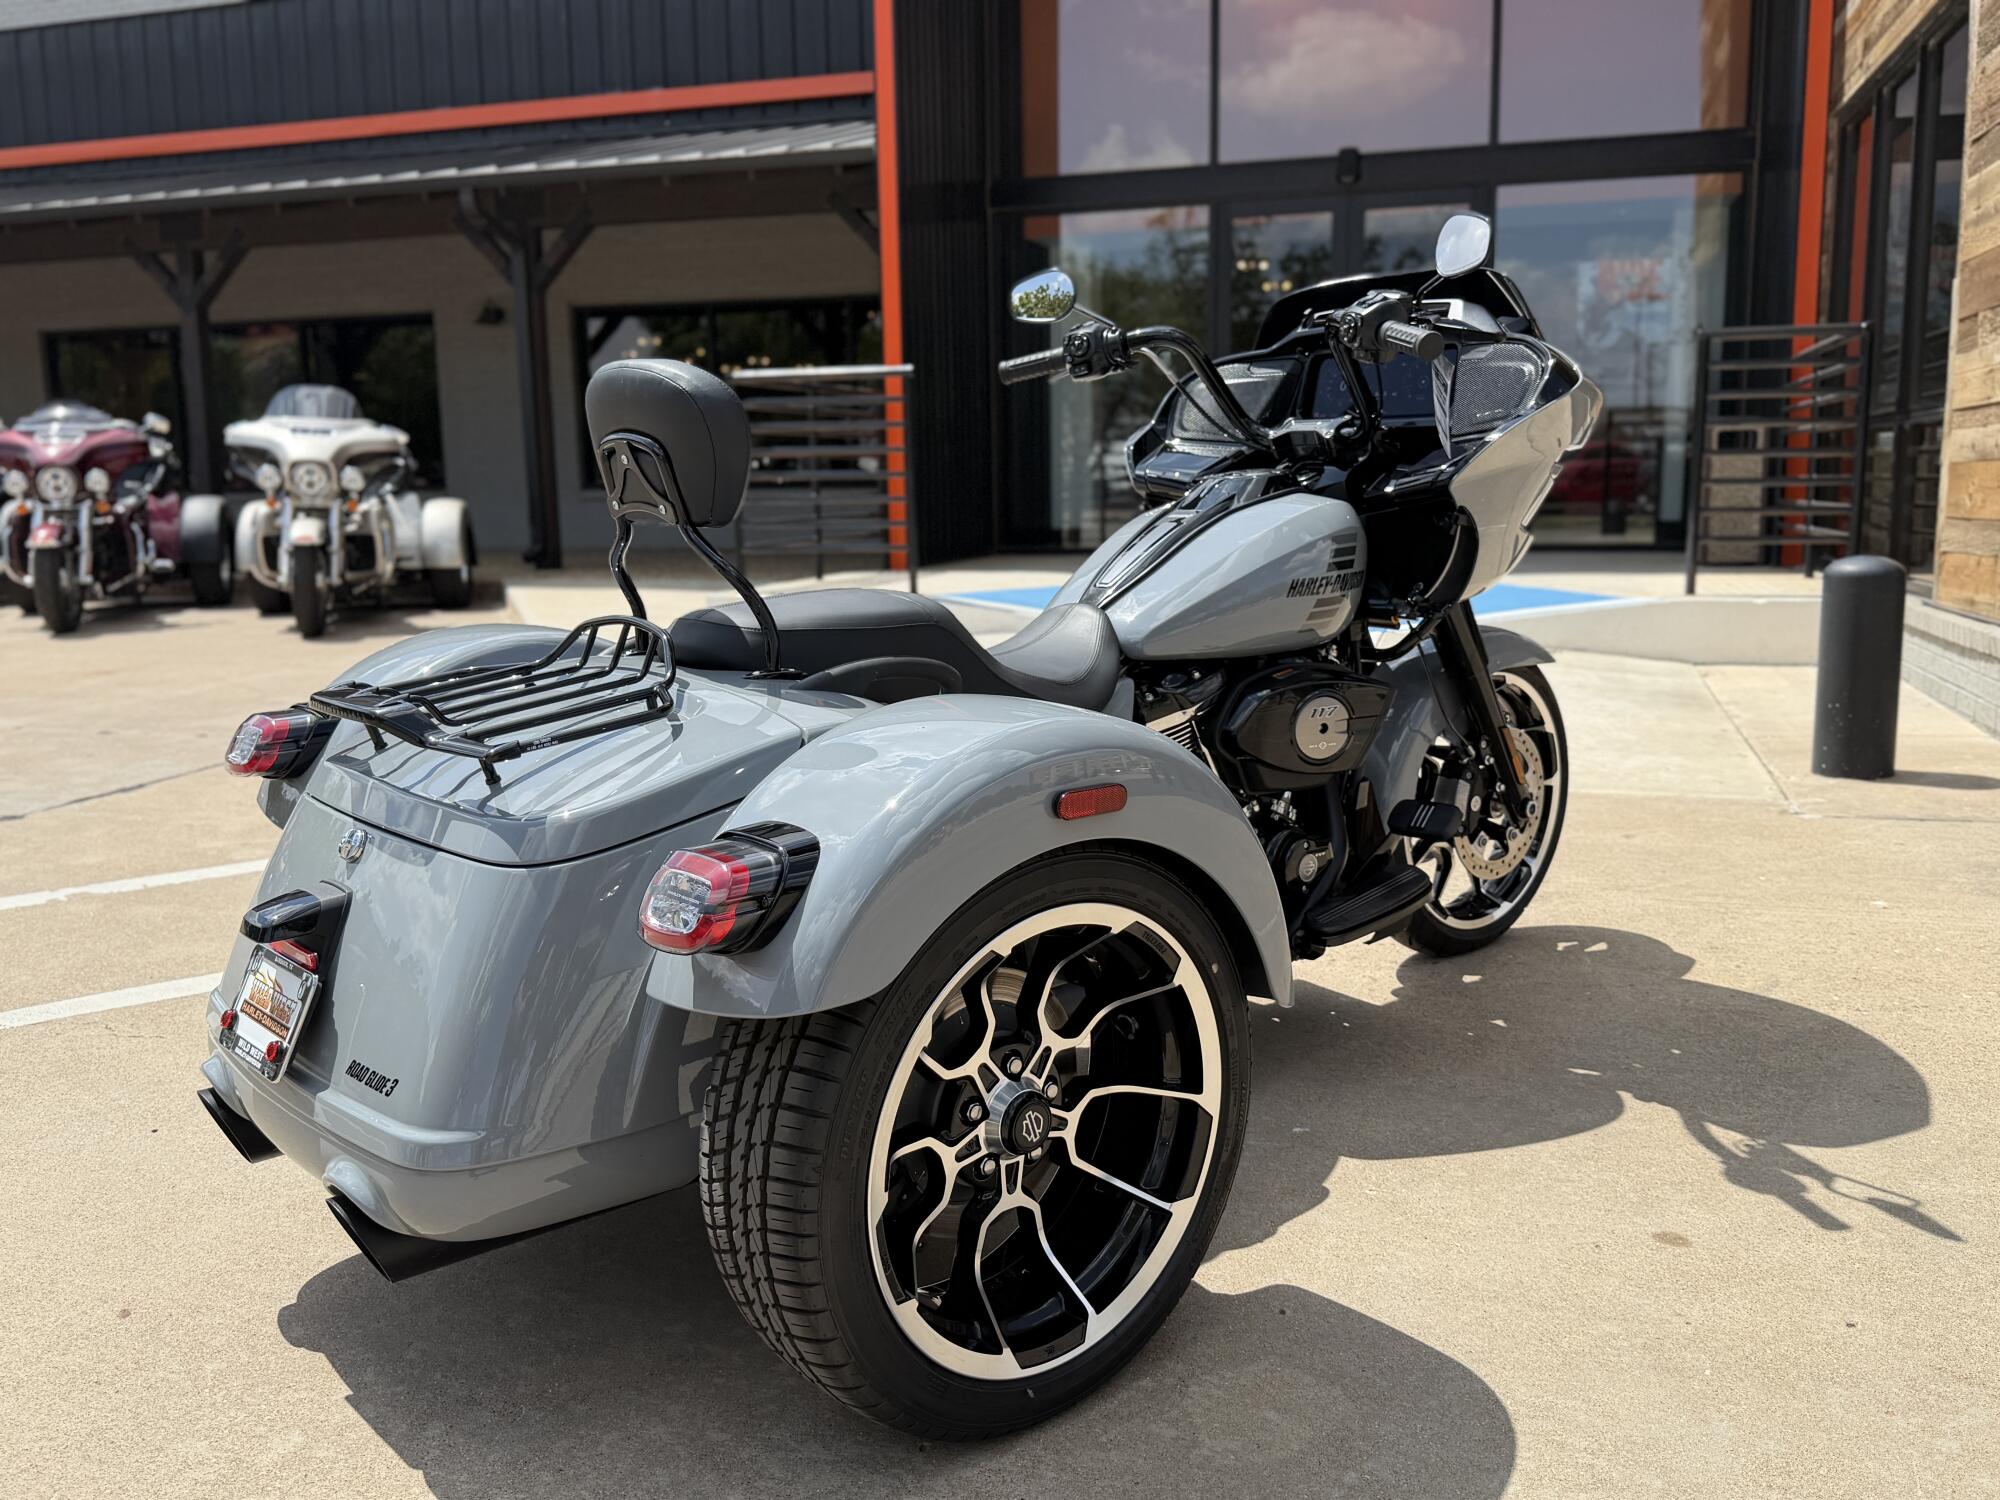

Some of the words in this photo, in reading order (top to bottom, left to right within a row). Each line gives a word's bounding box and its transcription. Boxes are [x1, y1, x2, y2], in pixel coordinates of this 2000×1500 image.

[1310, 704, 1339, 718] 117
[241, 1000, 289, 1038] HARLEY-DAVIDSON
[346, 1059, 370, 1082] ROAD
[364, 1070, 391, 1094] GLIDE
[384, 1078, 399, 1097] 3
